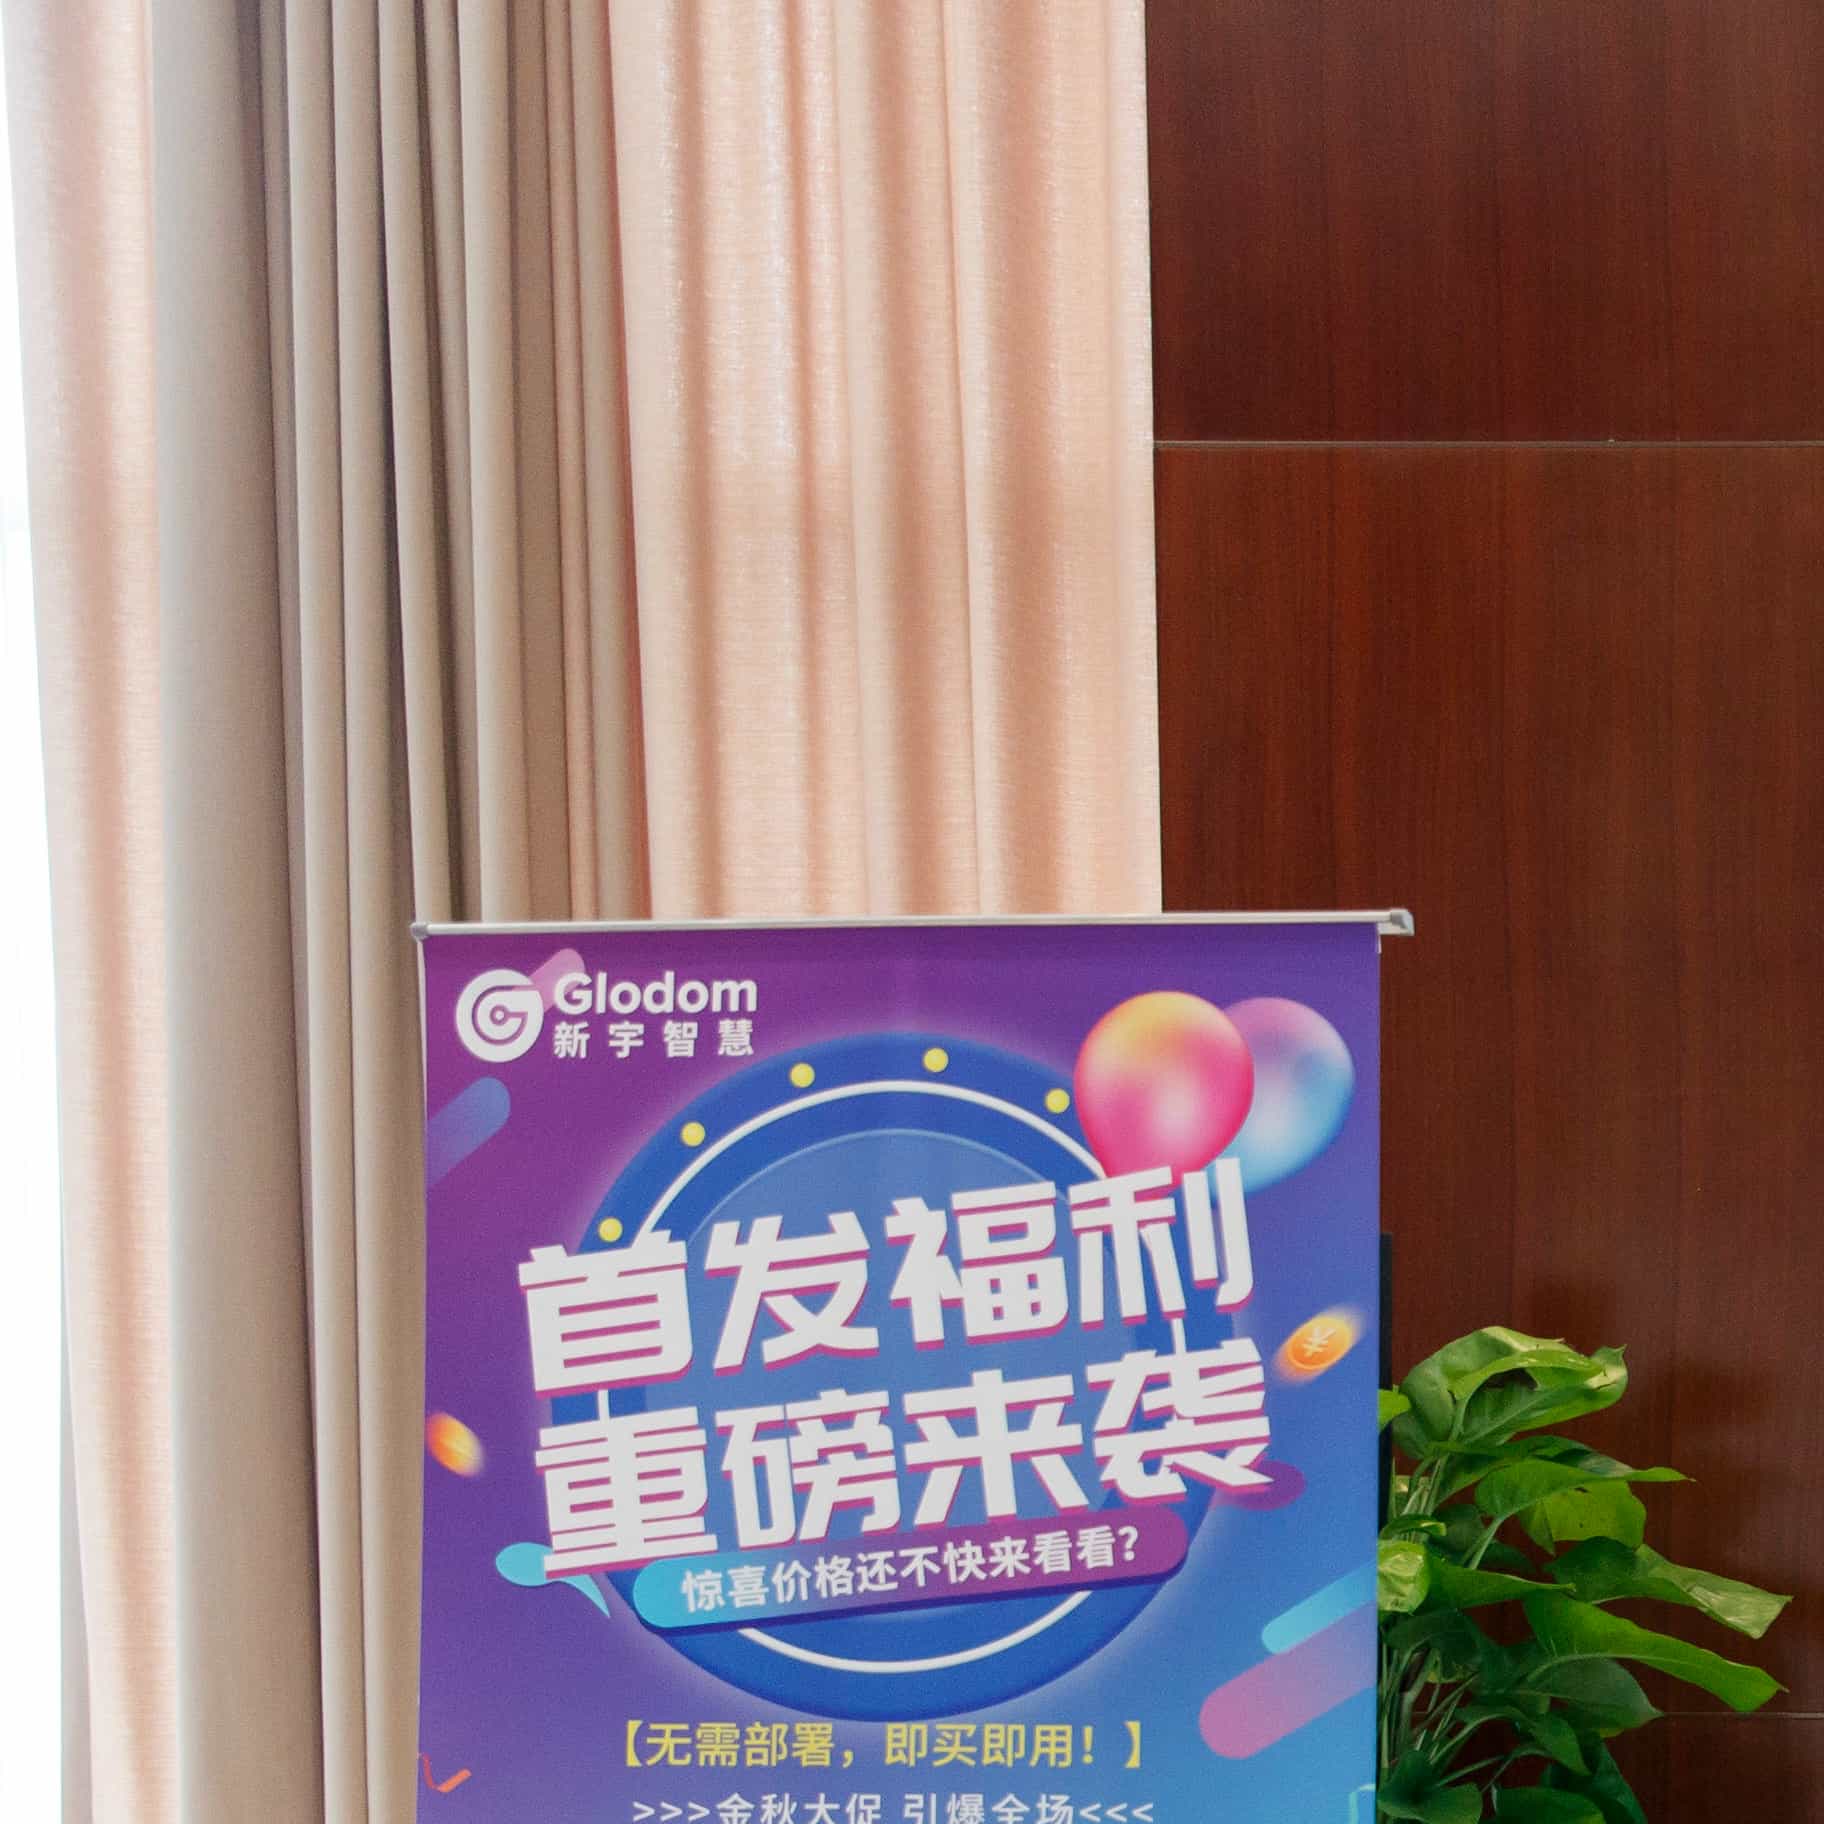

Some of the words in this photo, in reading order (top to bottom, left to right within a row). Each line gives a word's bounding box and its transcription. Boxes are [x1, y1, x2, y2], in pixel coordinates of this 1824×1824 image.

[554, 1020, 753, 1058] 新宇智慧
[555, 971, 757, 1014] Glodom
[518, 1157, 1254, 1391] 首发福利
[535, 1320, 1274, 1576] 重磅来袭
